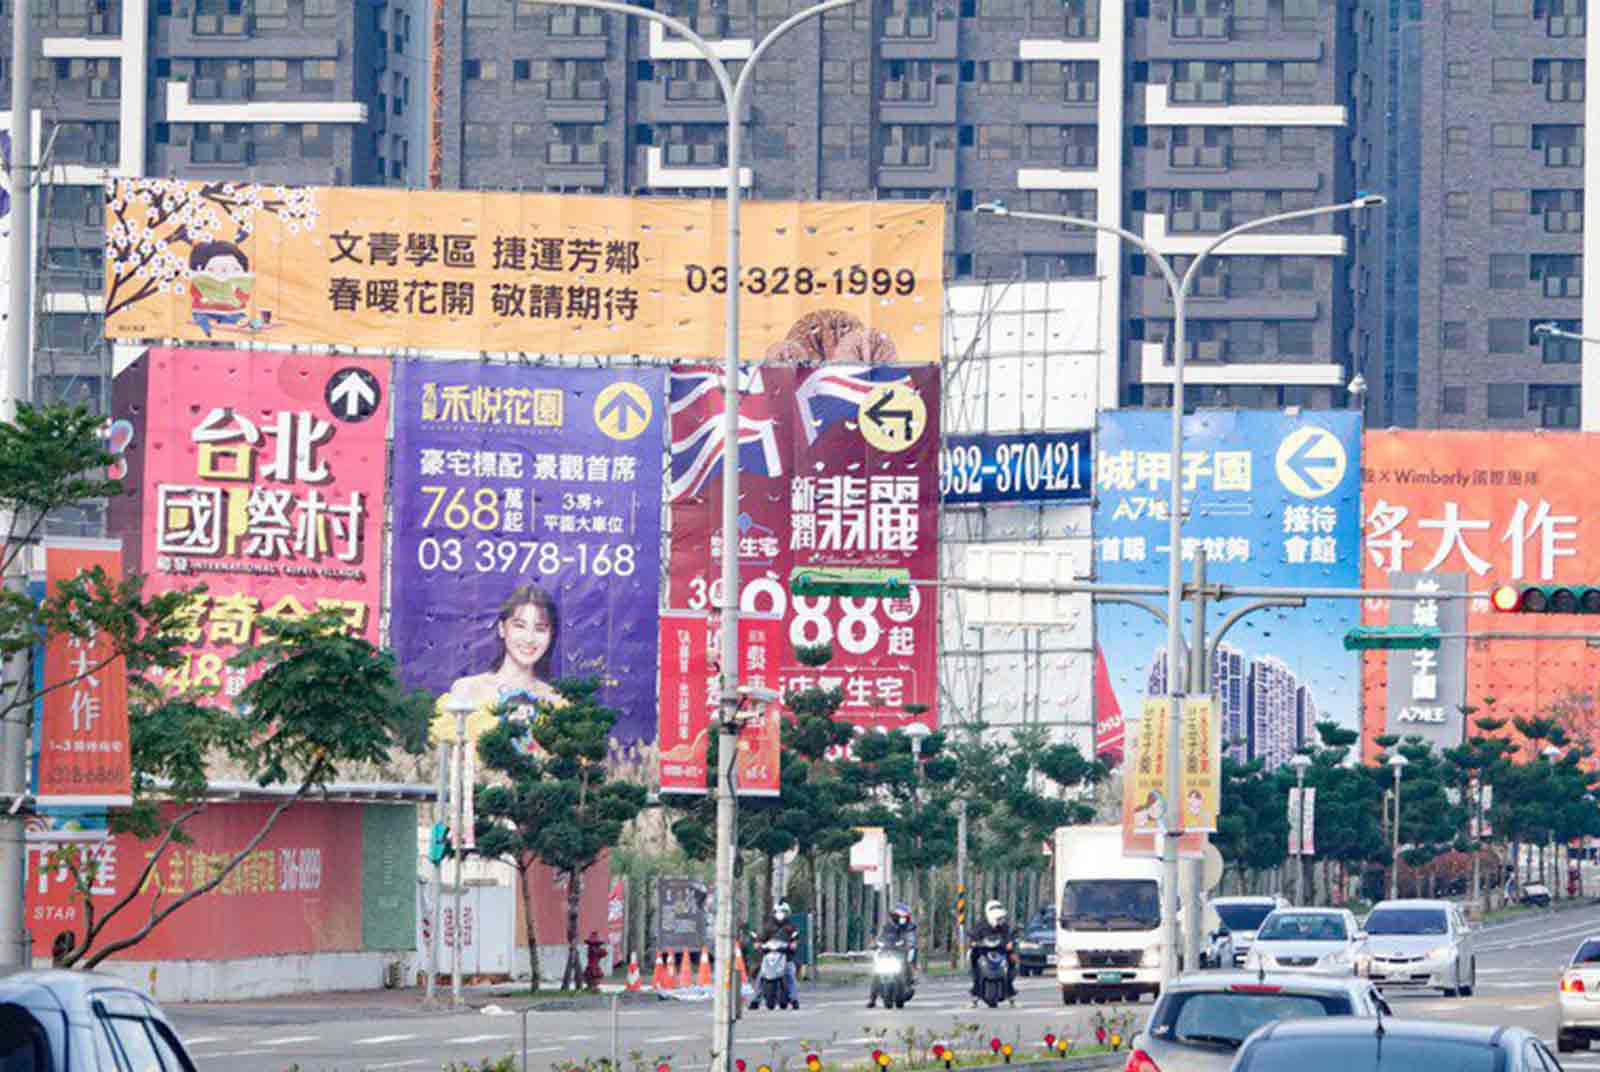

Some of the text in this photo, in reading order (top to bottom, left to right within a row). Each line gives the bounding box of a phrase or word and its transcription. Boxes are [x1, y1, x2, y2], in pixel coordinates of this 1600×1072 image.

[328, 230, 641, 275] 文青學區 捷運芳鄰
[328, 277, 639, 321] 春暖花開 敬請期待
[191, 407, 335, 485] 台北
[419, 448, 637, 483] 豪宅標配 景觀首席
[938, 441, 1082, 496] 932-370421
[157, 484, 364, 563] 國際村
[420, 486, 500, 531] 768
[790, 476, 817, 551] 新潤
[816, 475, 920, 551] 翡麗
[1282, 505, 1337, 533] 接待
[417, 537, 636, 577] 03 3978-168
[33, 905, 76, 921] STAR
